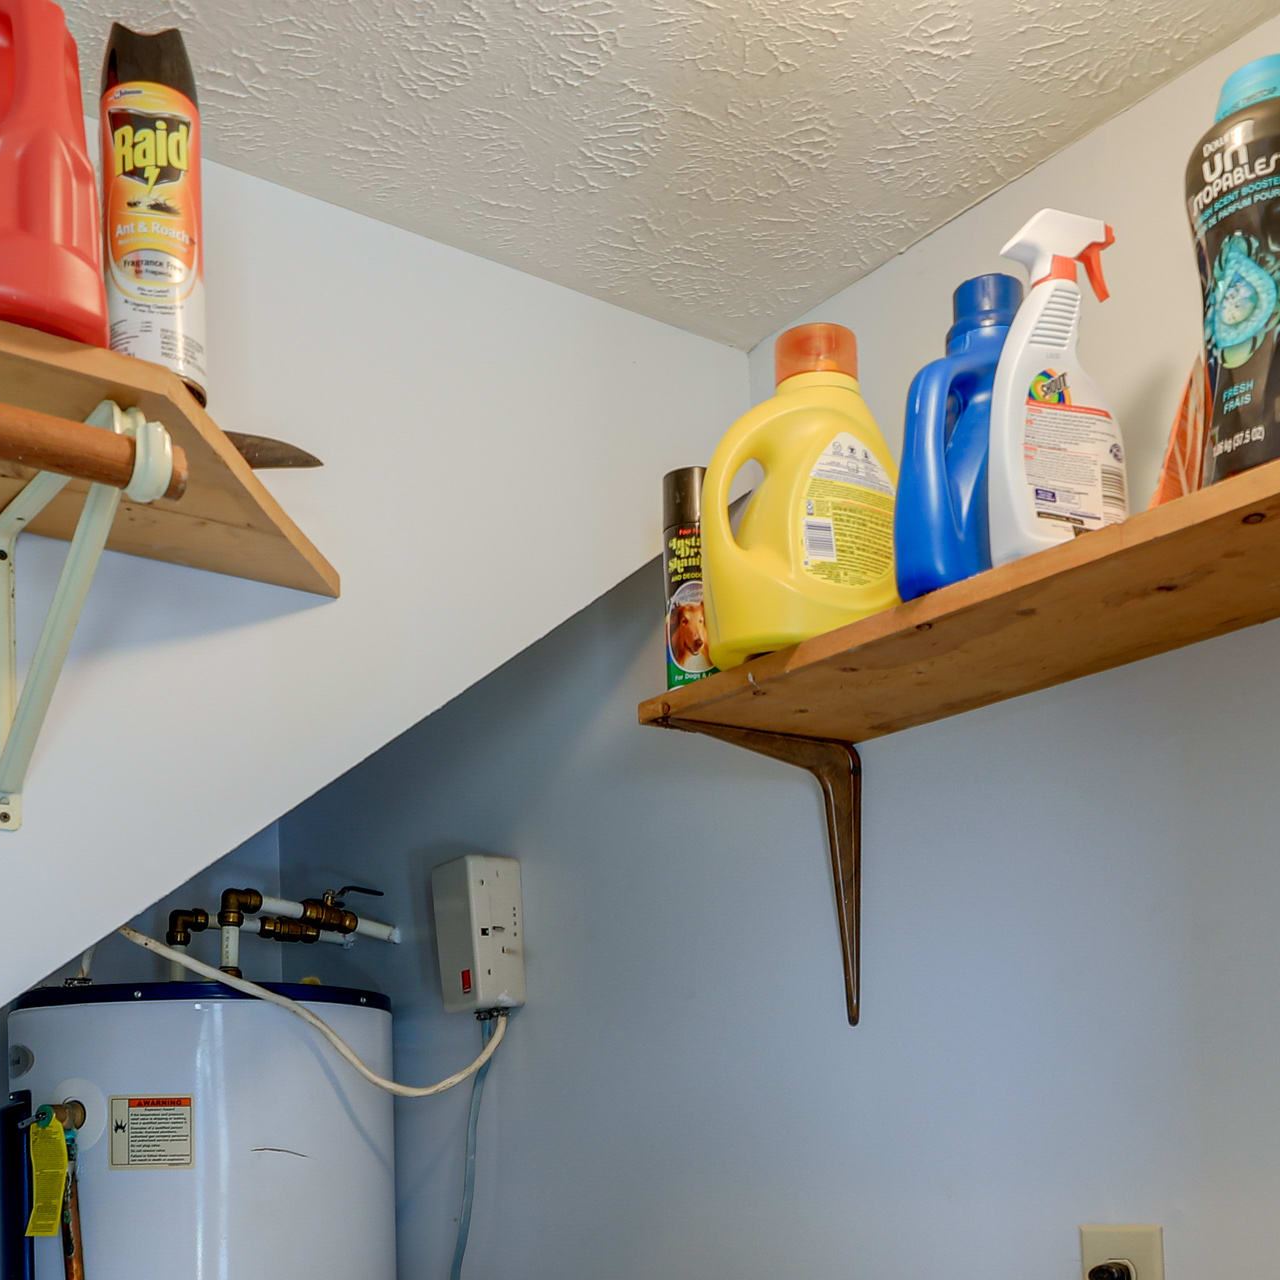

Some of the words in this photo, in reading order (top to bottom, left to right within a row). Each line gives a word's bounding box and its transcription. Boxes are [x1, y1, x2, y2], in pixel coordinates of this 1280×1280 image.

[114, 120, 188, 177] Raid
[1253, 186, 1280, 204] POUR
[116, 222, 135, 237] Ant
[138, 221, 148, 233] &
[151, 222, 190, 244] Roach
[124, 258, 164, 270] Fragrance
[1041, 372, 1068, 398] SHOUT
[1223, 379, 1254, 402] FRESH
[1224, 393, 1252, 415] FRAIS
[685, 673, 701, 681] Dogs
